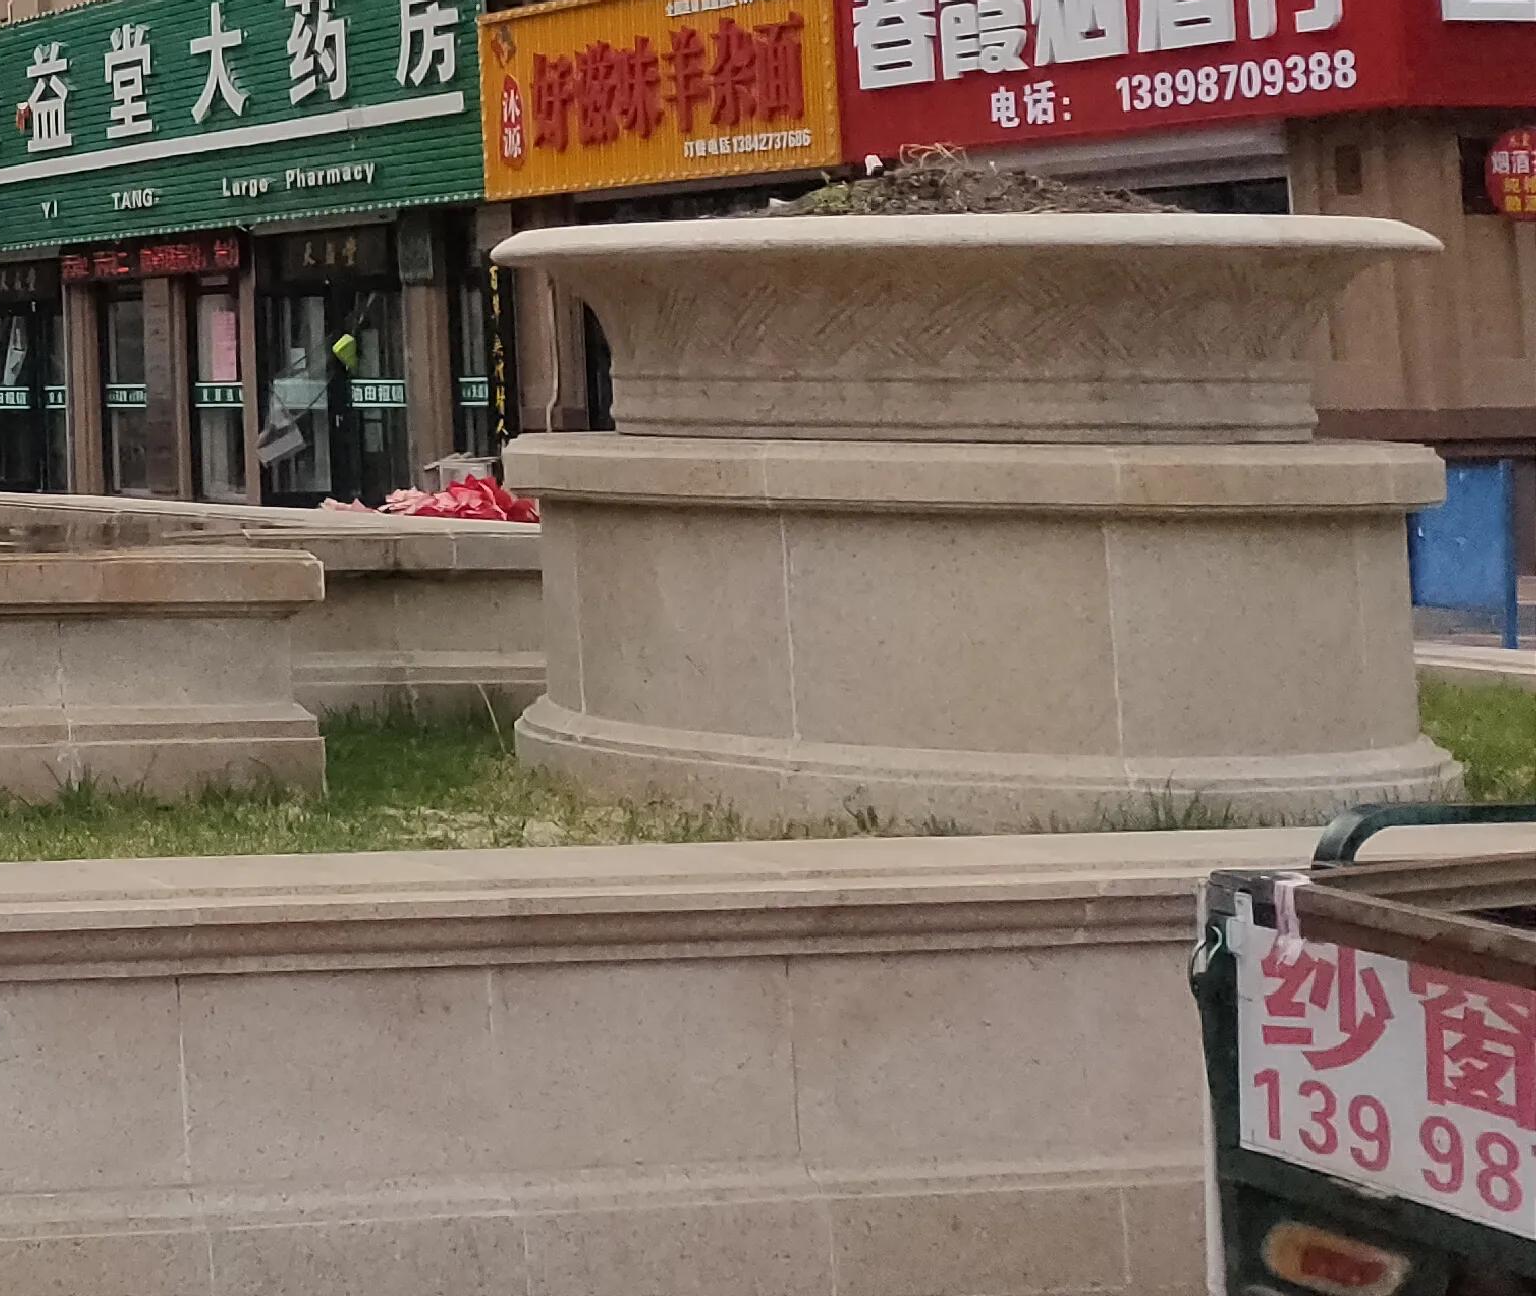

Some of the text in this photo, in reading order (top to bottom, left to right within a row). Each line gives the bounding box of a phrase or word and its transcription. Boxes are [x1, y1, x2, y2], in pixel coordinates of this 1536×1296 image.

[1116, 49, 1358, 112] 13898709388
[41, 200, 59, 219] YI
[112, 189, 154, 211] TANG
[222, 177, 269, 198] Large
[285, 161, 376, 190] Pharmacy
[1261, 945, 1536, 1131] 纱窗
[1253, 1068, 1536, 1212] 139 98
